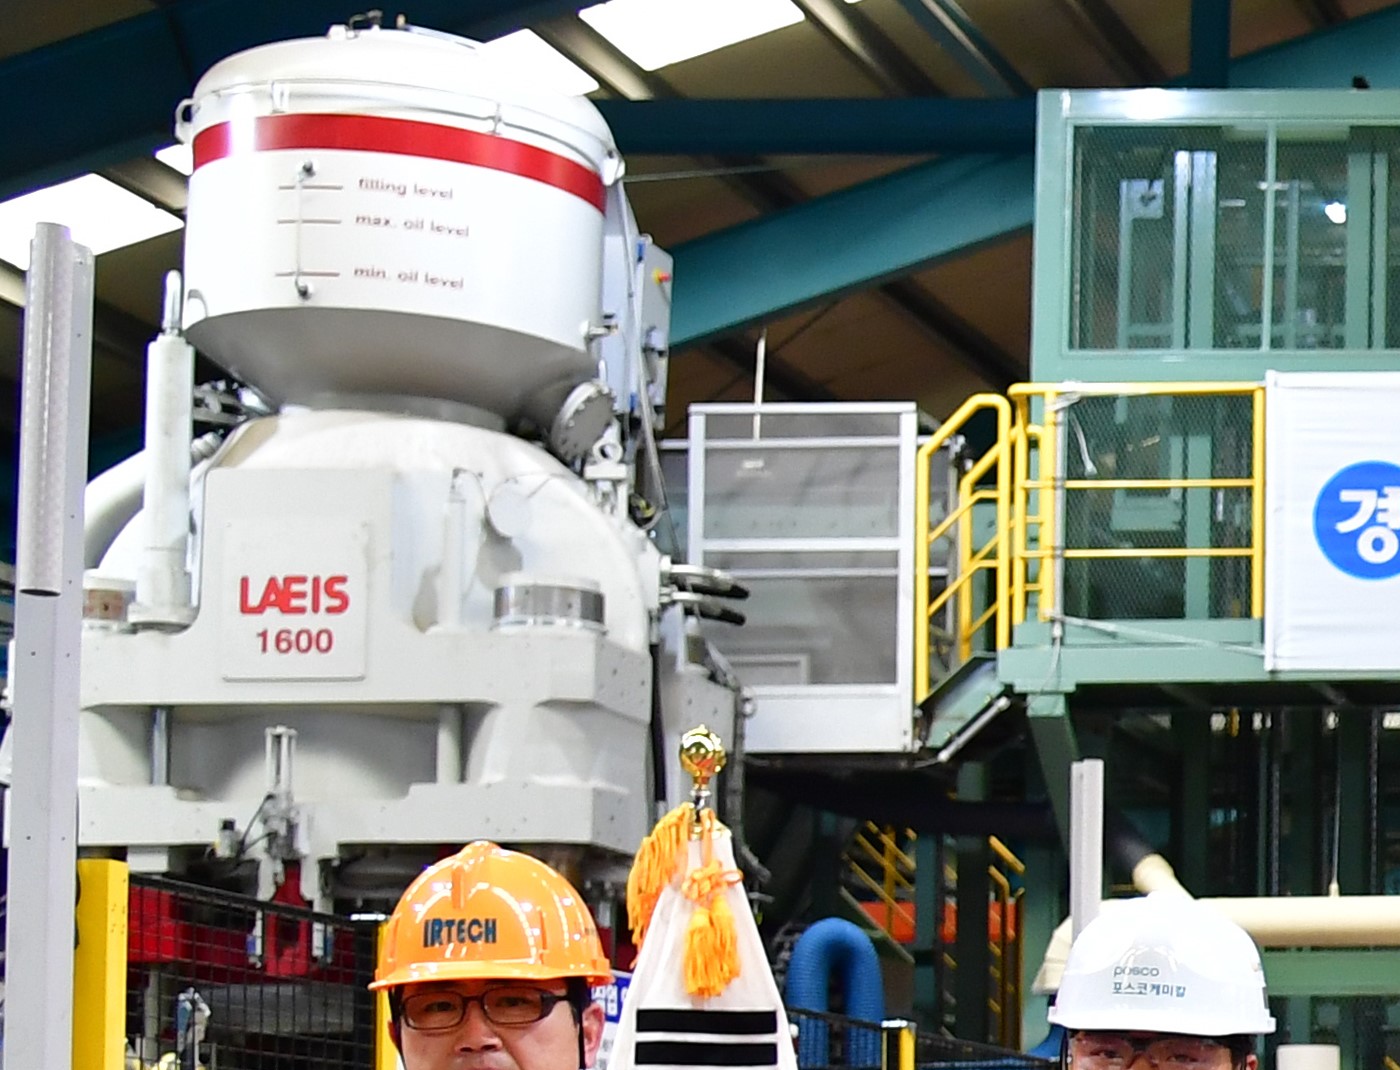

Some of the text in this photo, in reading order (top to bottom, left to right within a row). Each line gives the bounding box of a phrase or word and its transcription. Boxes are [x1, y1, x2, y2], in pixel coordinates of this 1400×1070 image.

[358, 177, 454, 199] filling level
[403, 217, 425, 231] oil
[430, 220, 470, 237] level
[397, 270, 419, 283] oil
[424, 272, 464, 290] level
[239, 575, 350, 614] LAEIS
[256, 628, 334, 654] 1600
[423, 917, 498, 948] IRTECH
[1113, 966, 1160, 978] posco
[1112, 981, 1187, 998] 포스코케미칼
